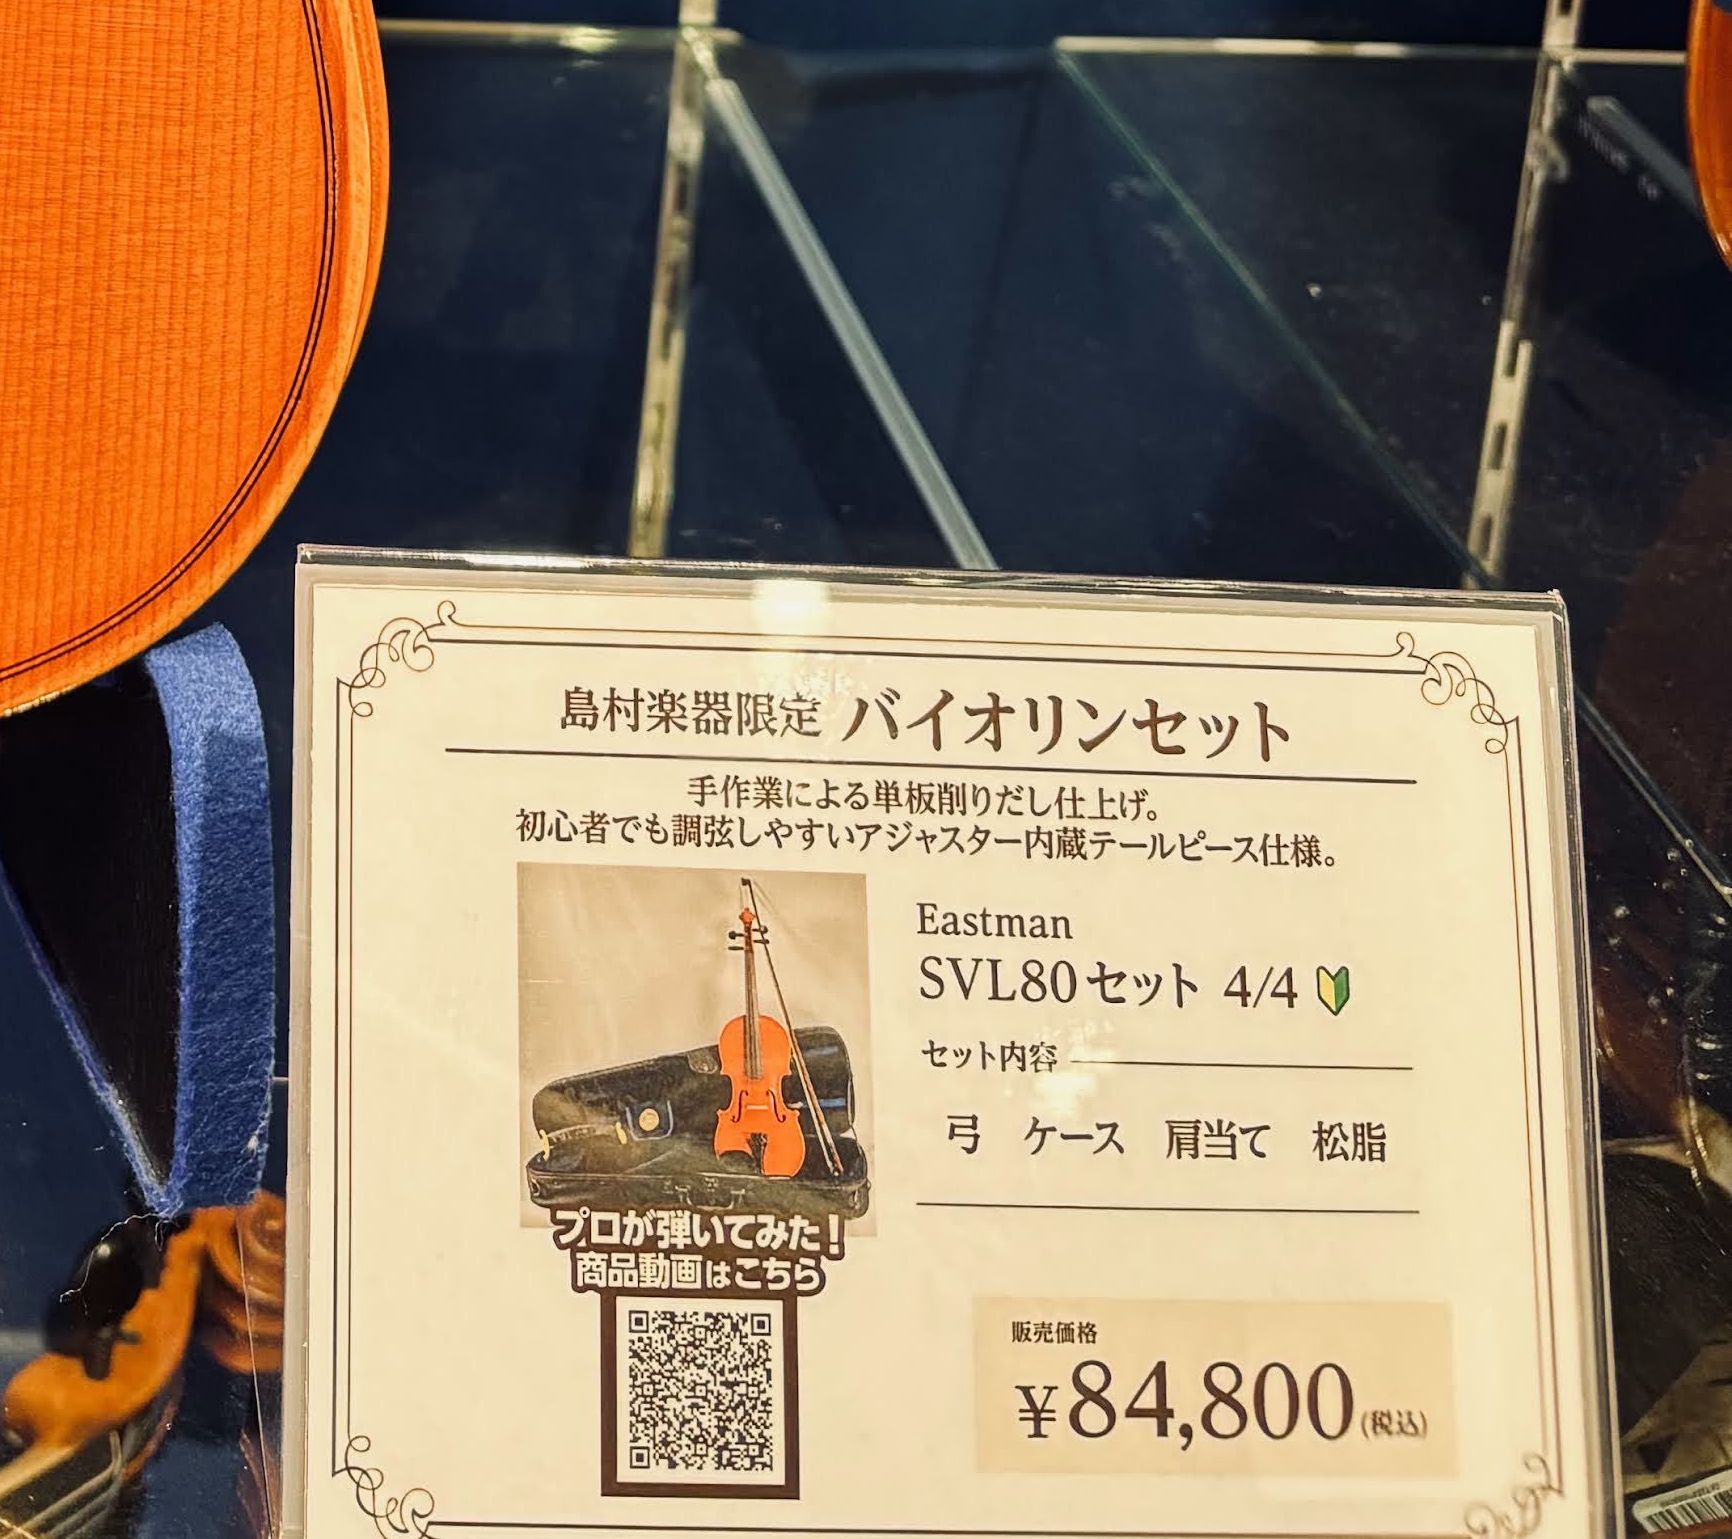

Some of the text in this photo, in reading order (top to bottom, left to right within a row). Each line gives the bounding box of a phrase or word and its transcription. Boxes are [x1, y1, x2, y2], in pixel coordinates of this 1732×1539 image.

[560, 686, 1290, 762] 島村楽器限定 バイオリンセット
[686, 773, 1159, 822] 手作業による単板削りだし仕上げ。
[916, 902, 1074, 939] Eastman
[1223, 965, 1298, 1008] 4/4
[921, 1039, 1058, 1073] セット内容
[947, 1114, 1387, 1162] 弓 ケース 肩当て 松脂
[576, 1252, 821, 1291] 商品動画はこちら
[1011, 1320, 1097, 1345] 販売価格
